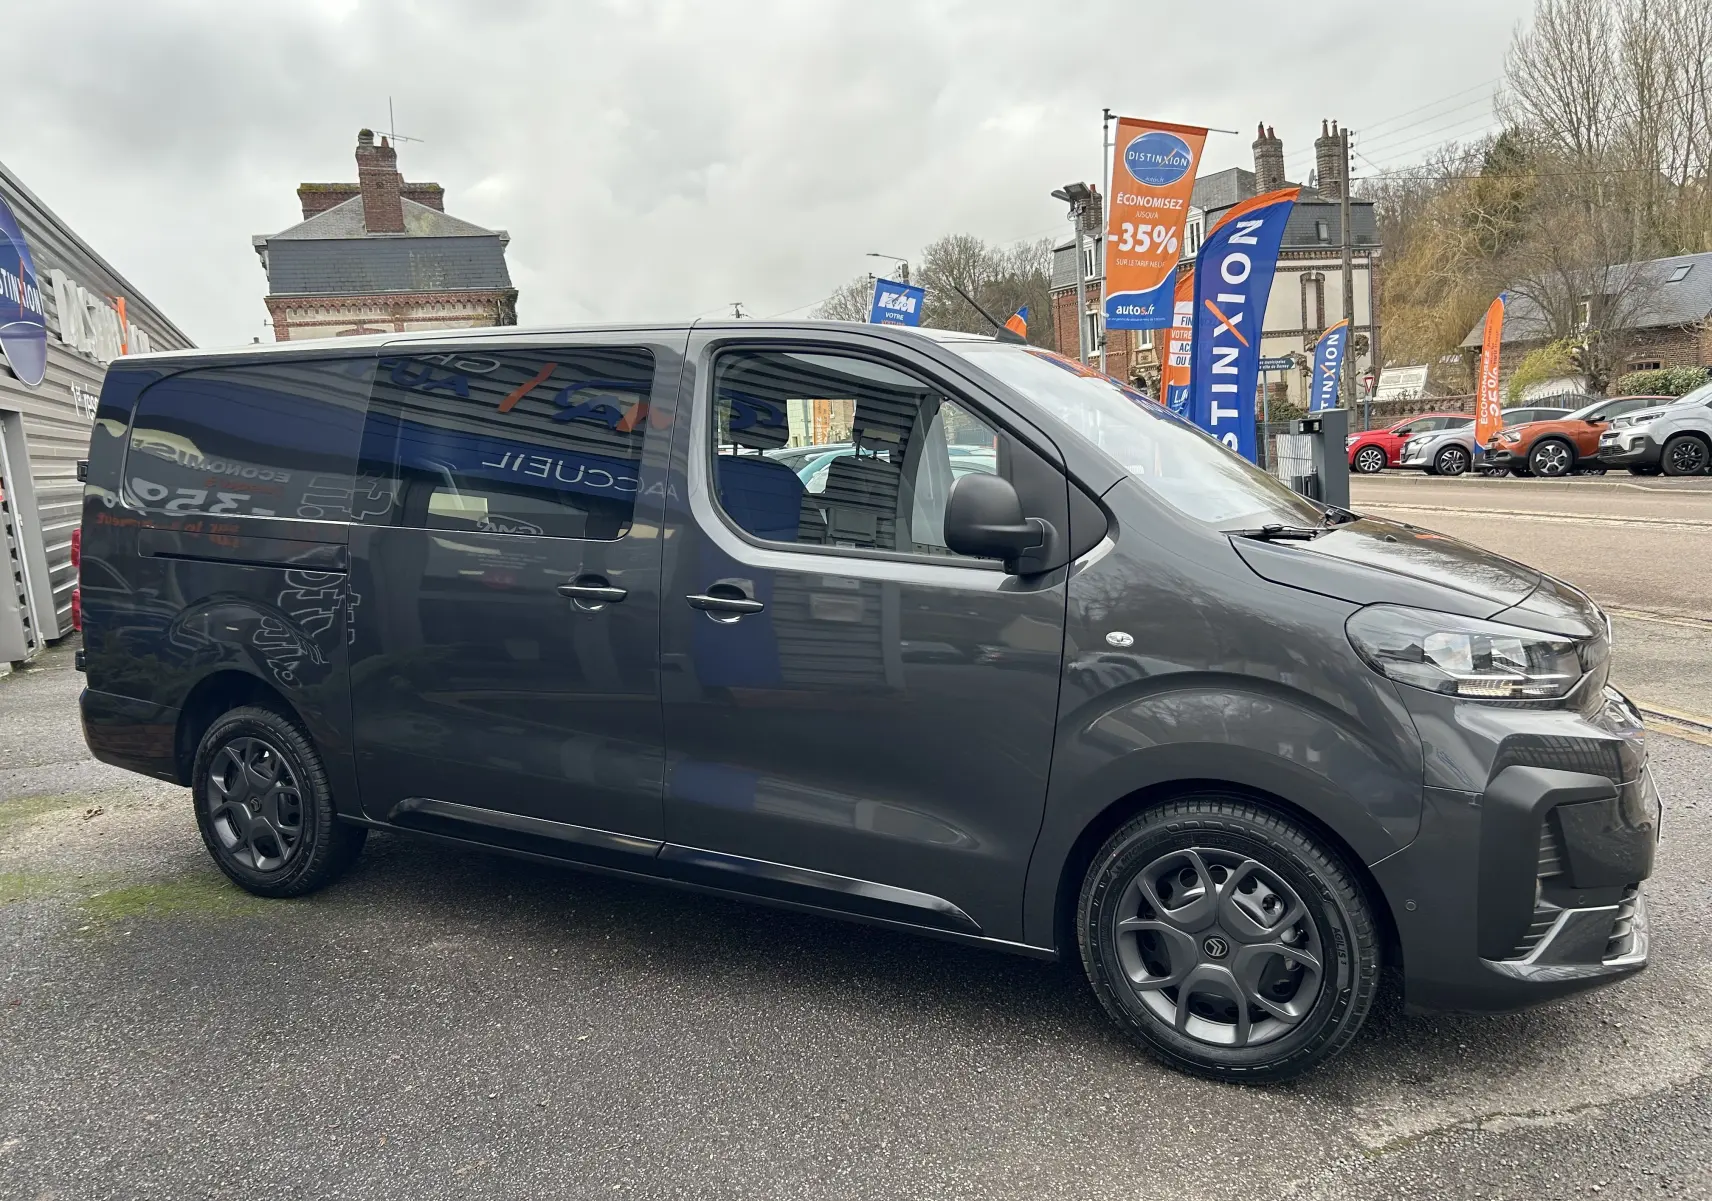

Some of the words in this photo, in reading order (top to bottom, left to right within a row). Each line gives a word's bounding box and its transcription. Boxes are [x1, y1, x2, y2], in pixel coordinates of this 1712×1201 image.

[1128, 149, 1188, 167] DISTINXION
[1116, 192, 1183, 209] ÉCONOMISEZ
[1108, 222, 1178, 254] -35%
[1116, 258, 1128, 266] SUR
[1116, 304, 1155, 315] autos.fr
[885, 312, 904, 321] VOTRE
[1171, 329, 1192, 339] VOTRE
[1175, 356, 1187, 366] OU
